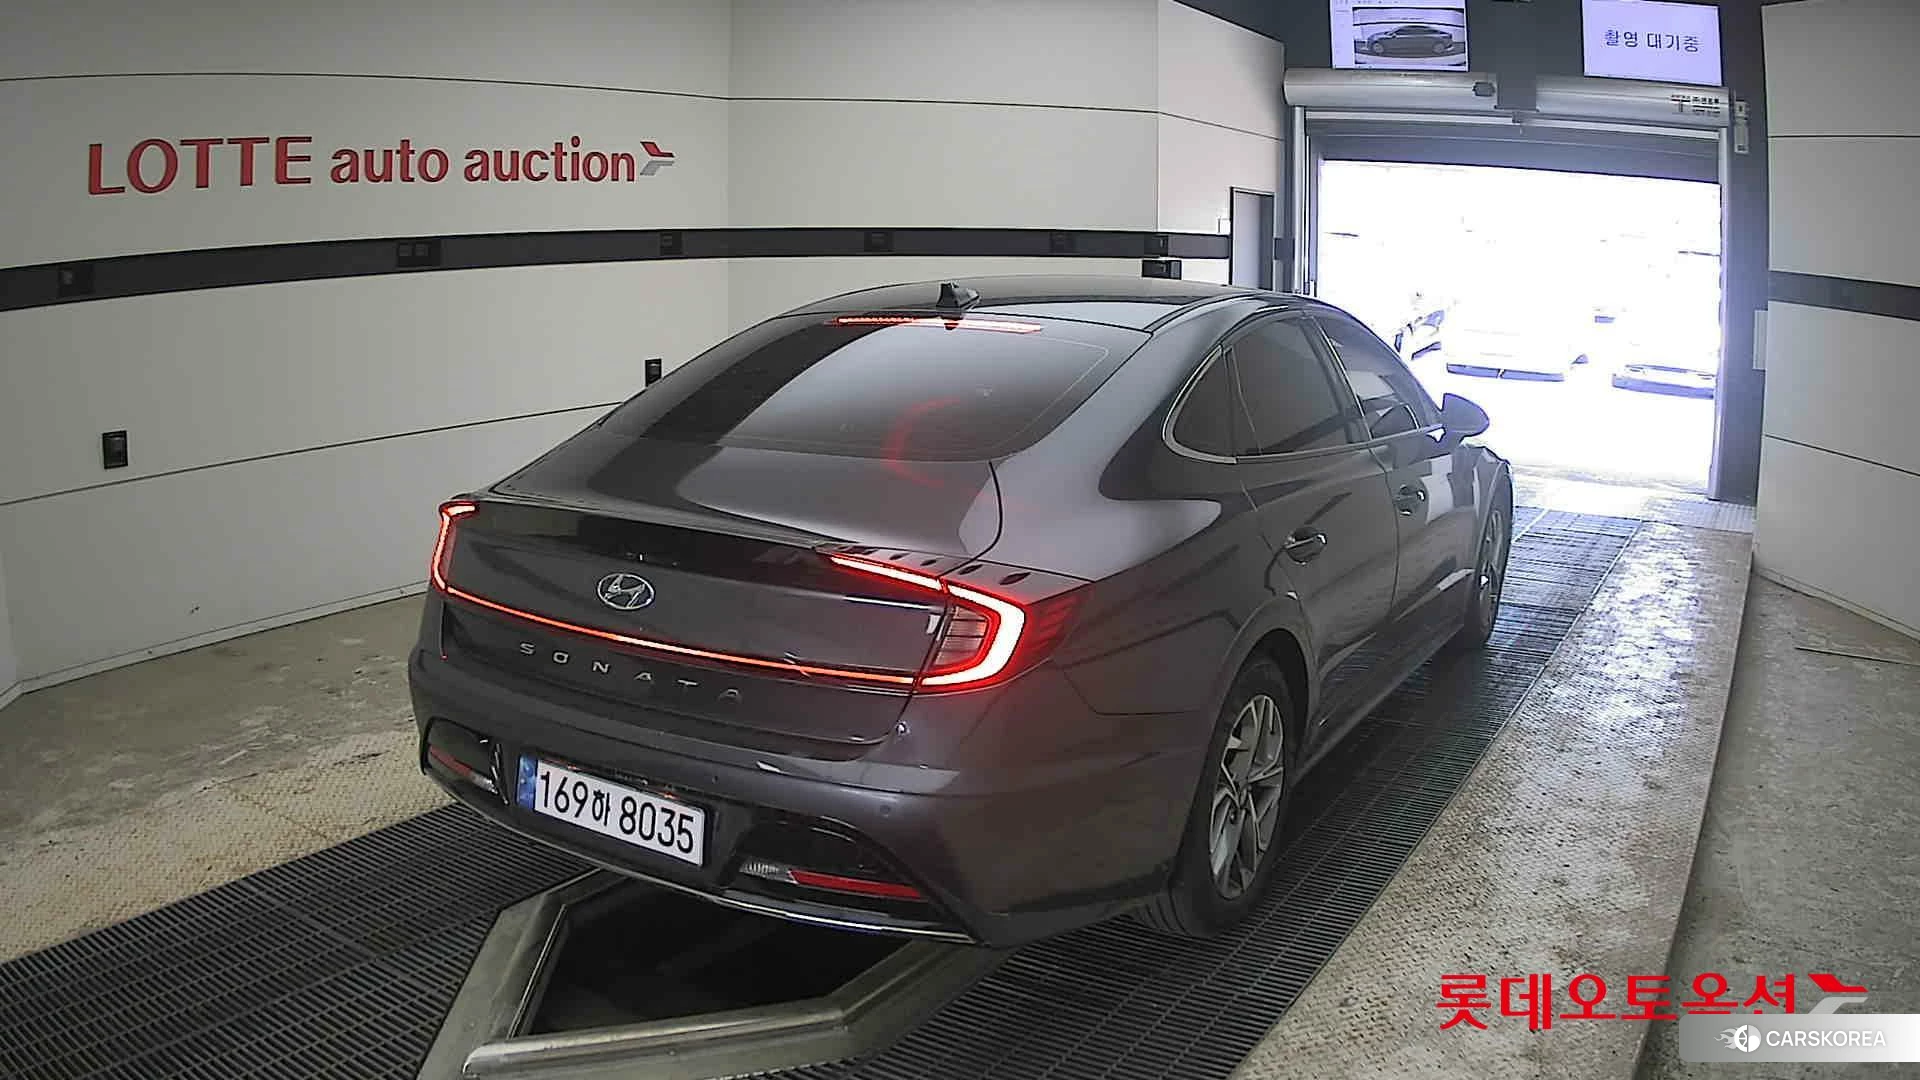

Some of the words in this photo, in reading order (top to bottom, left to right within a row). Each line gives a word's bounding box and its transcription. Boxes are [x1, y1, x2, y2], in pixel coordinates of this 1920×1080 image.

[1604, 29, 1639, 48] 촬영
[1646, 32, 1699, 53] 대기중
[88, 136, 312, 195] LOTTE
[329, 138, 449, 184] auto
[463, 136, 637, 184] auction
[519, 641, 743, 703] SONATA
[540, 770, 611, 827] 169하
[618, 795, 695, 855] 8035
